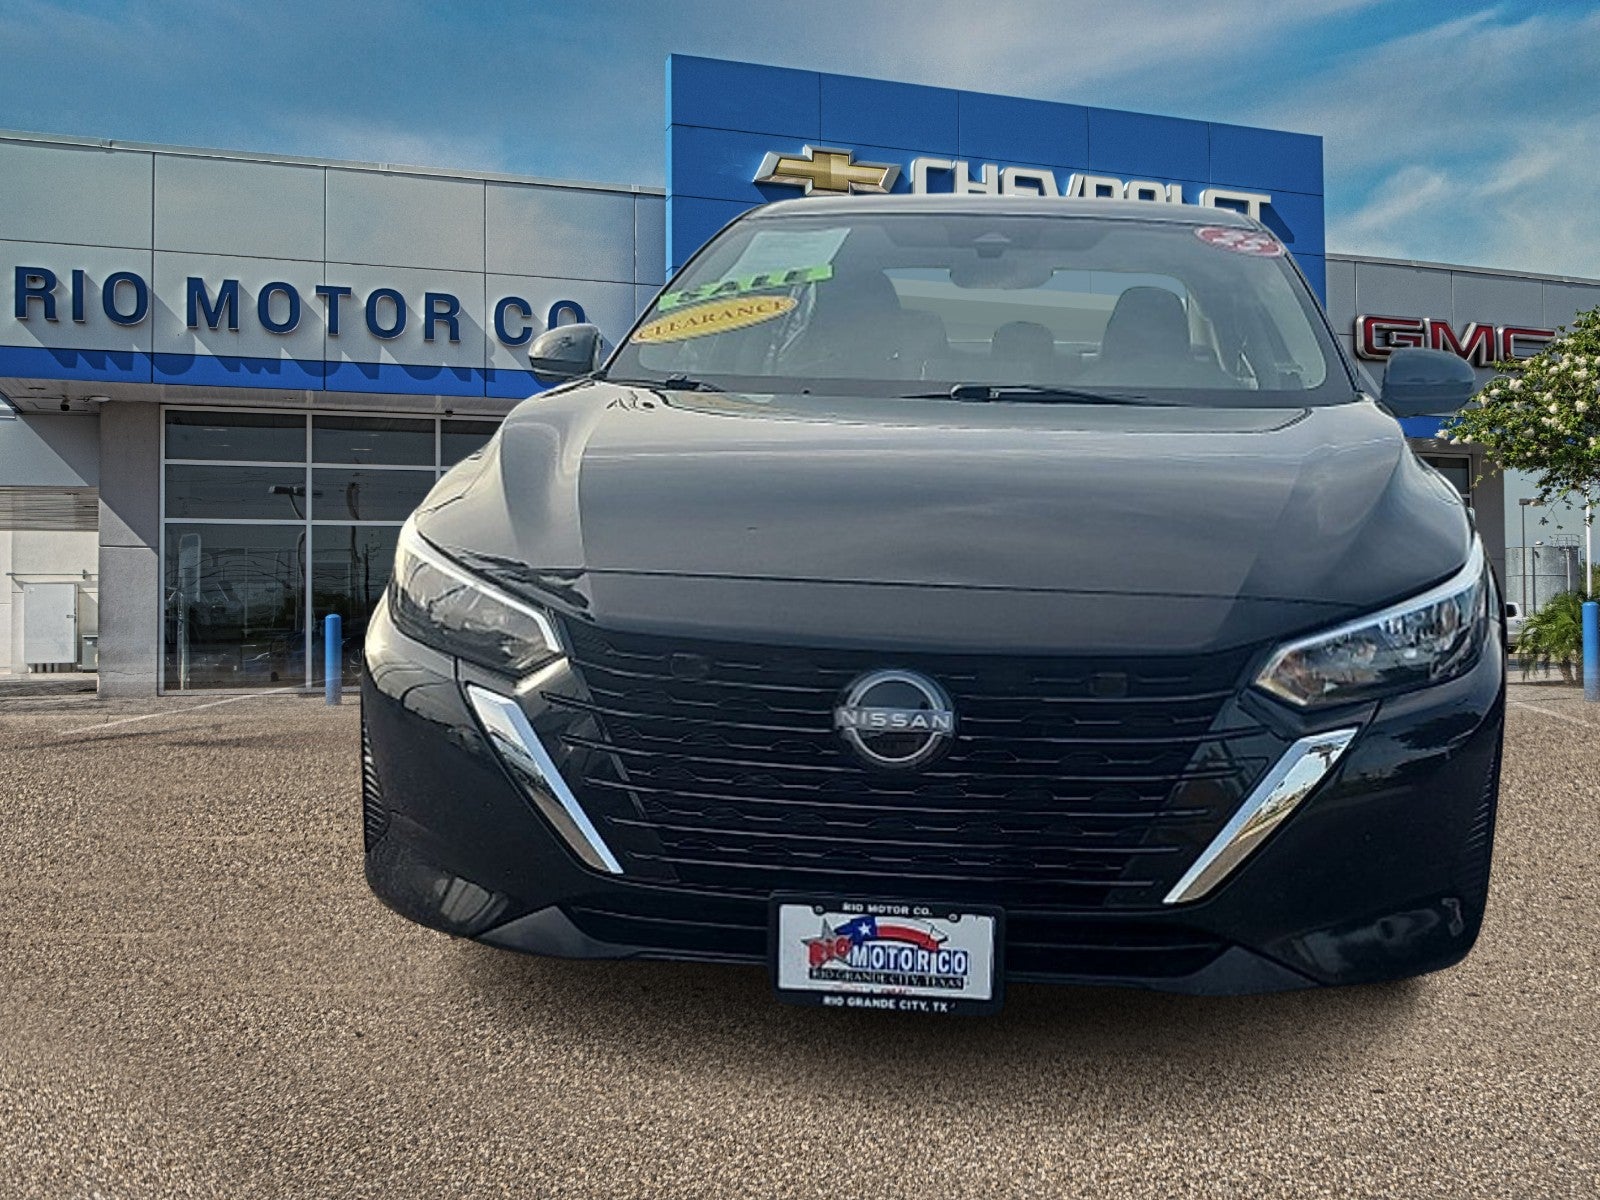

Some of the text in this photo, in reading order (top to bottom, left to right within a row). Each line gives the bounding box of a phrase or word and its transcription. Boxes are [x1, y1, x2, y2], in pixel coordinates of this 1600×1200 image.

[14, 265, 148, 325] RIO
[186, 276, 461, 342] MOTOR
[638, 301, 787, 339] CLEARANCE
[1354, 313, 1557, 367] GMC
[841, 711, 951, 729] NISSAN
[842, 901, 933, 915] RIO MOTOR CO.
[835, 970, 887, 985] GRANDE
[822, 996, 948, 1013] RIO GRANDE CITY, TX
